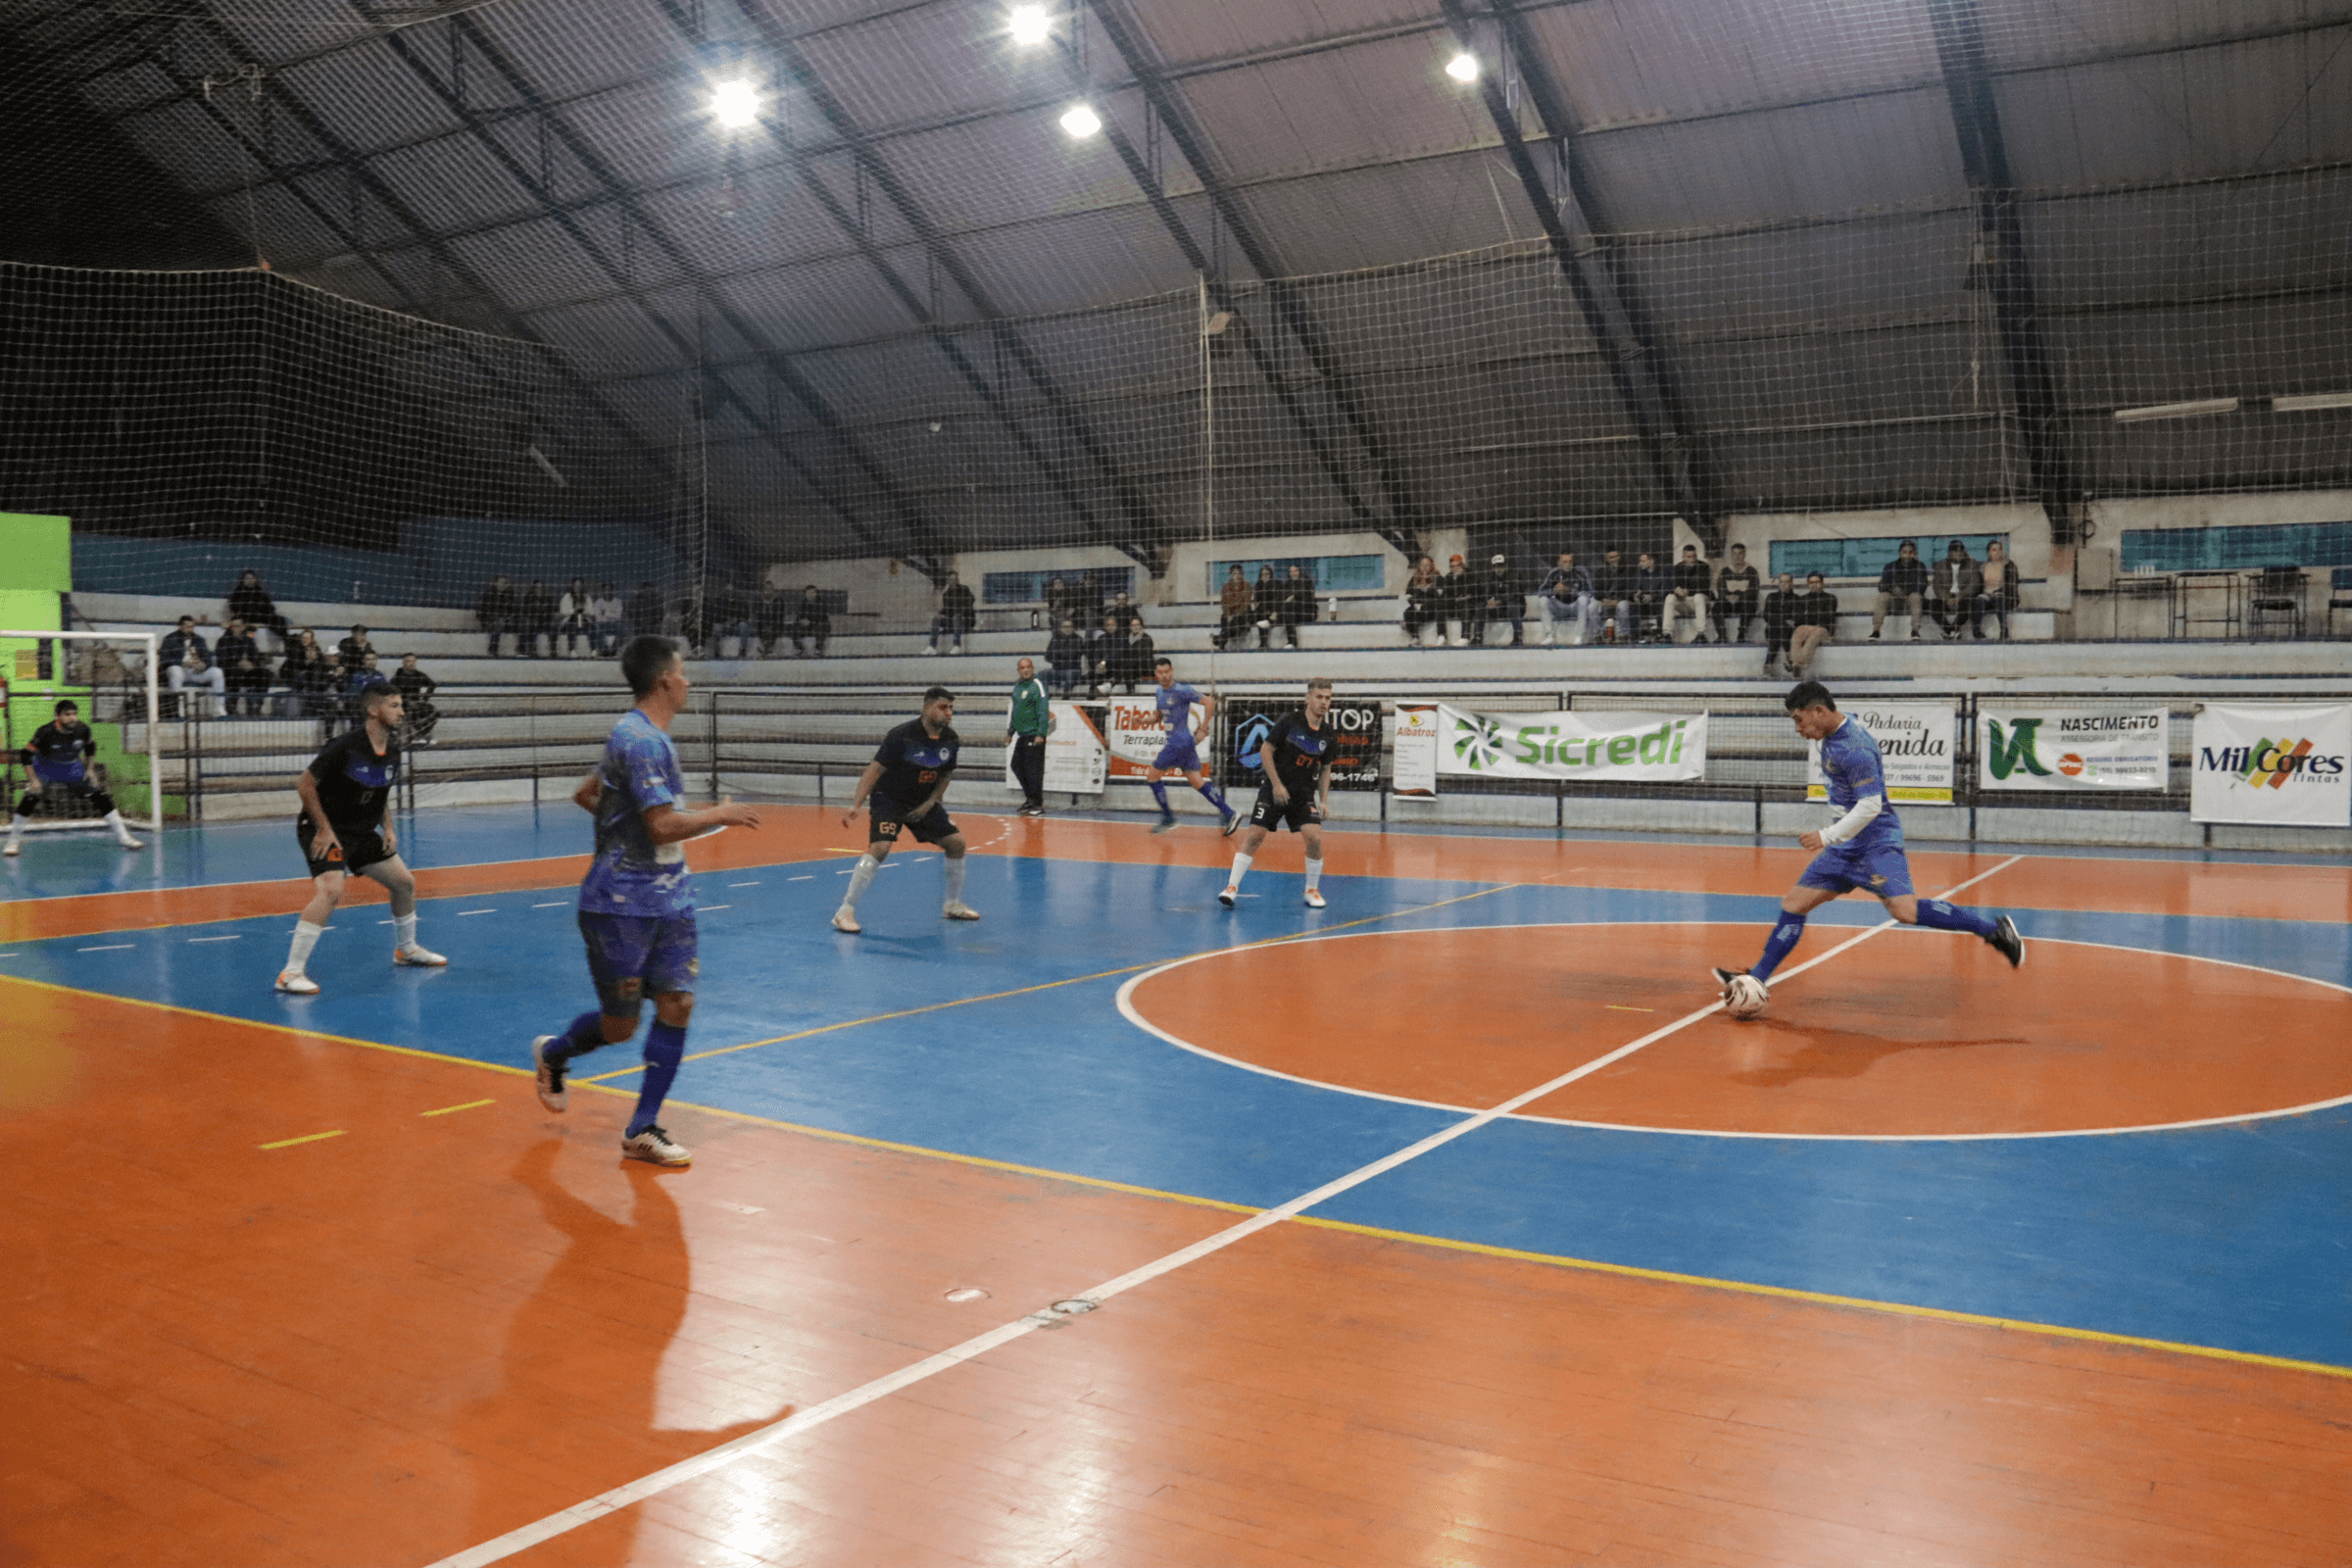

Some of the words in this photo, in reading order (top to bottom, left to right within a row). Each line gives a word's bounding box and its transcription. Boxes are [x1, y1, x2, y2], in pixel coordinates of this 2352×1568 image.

[1863, 711, 1922, 730] Padaria
[2060, 715, 2159, 731] NASCIMENTO
[1396, 726, 1436, 737] Albatroz
[1515, 719, 1687, 766] Sicredi
[2198, 747, 2250, 771] Mil
[2257, 747, 2344, 774] Cores
[2292, 773, 2340, 783] Tintas
